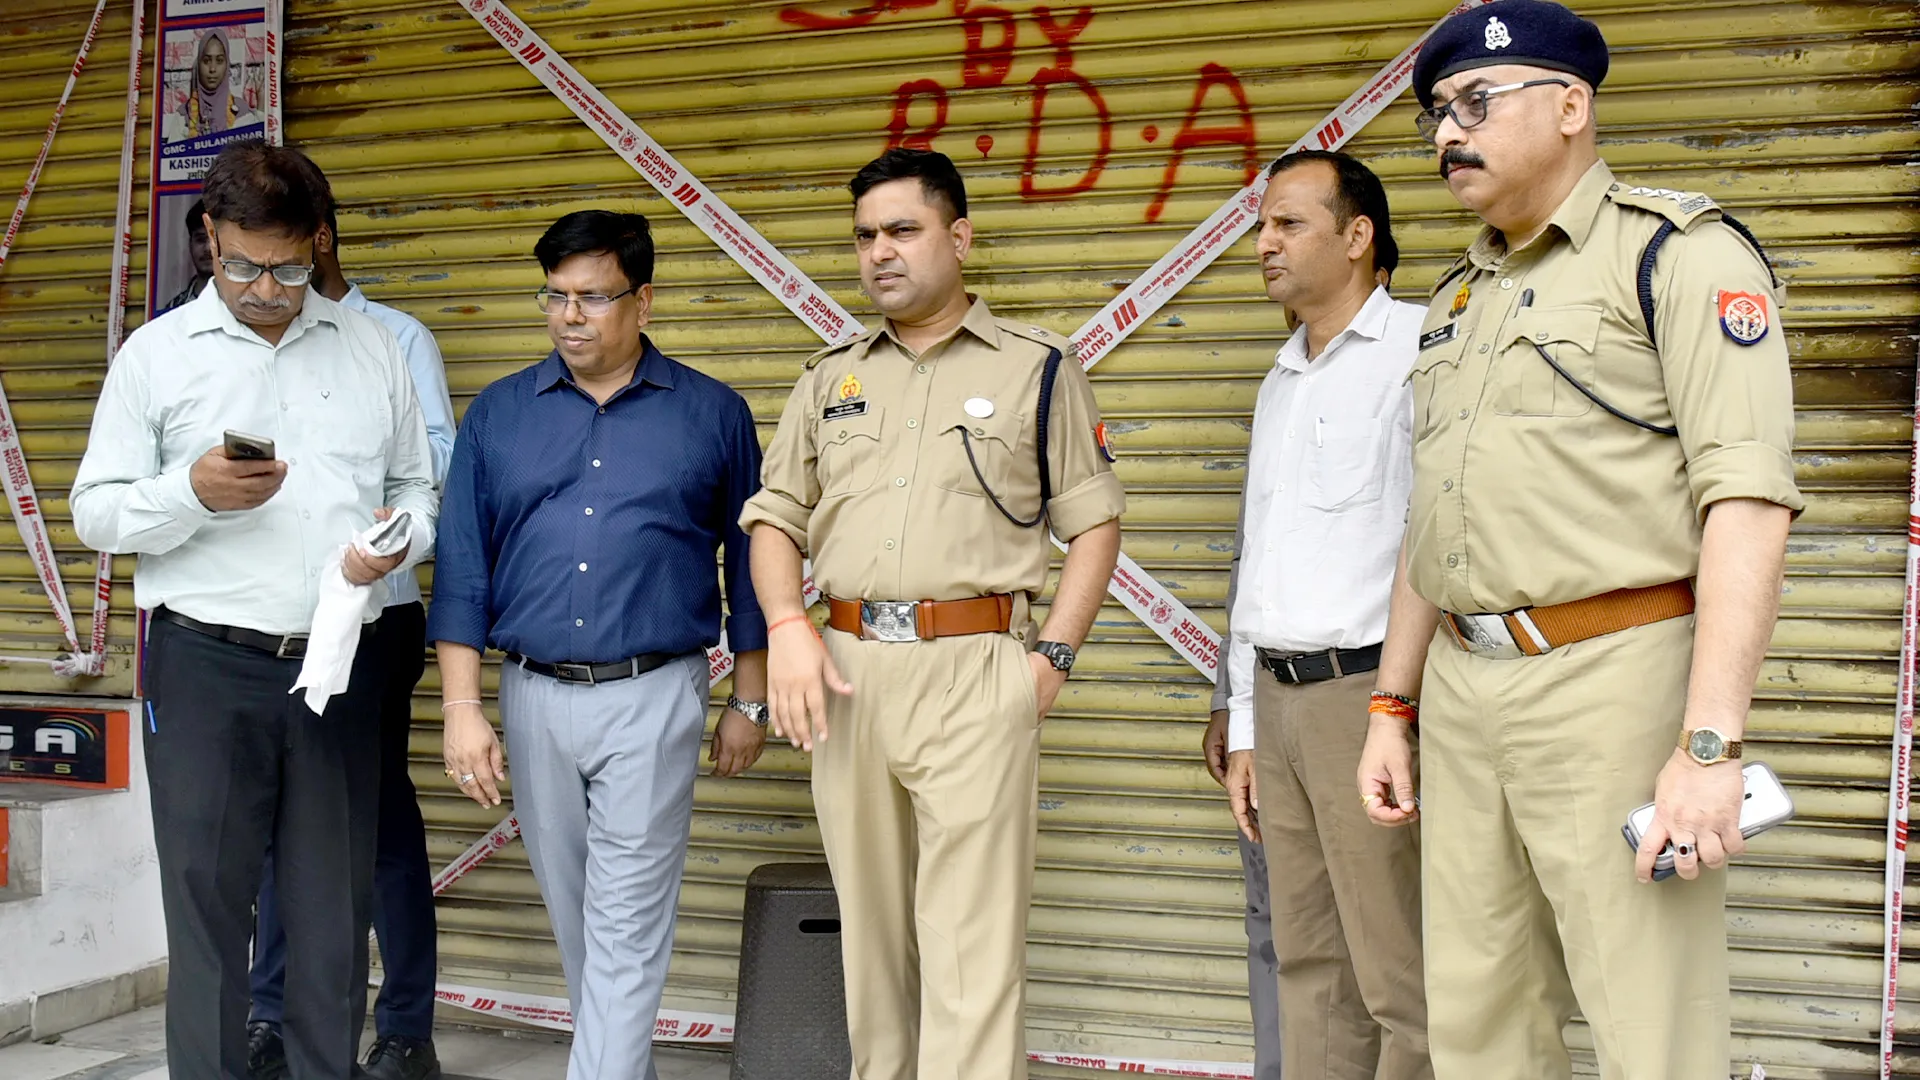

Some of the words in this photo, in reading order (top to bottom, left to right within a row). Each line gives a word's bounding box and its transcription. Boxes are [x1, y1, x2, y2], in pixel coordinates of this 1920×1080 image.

[484, 15, 519, 47] CAUTION
[493, 9, 525, 40] DANGER
[957, 6, 1094, 88] BY
[266, 60, 278, 108] CAUTION
[163, 142, 187, 156] GMC
[643, 147, 677, 179] DANGER
[635, 154, 673, 188] CAUTION
[3, 208, 25, 248] DANGER
[800, 302, 840, 338] CAUTION
[808, 295, 845, 329] DANGER
[1076, 324, 1105, 350] DANG
[4, 449, 22, 490] CAUTION
[11, 447, 28, 487] DANGER
[708, 649, 724, 664] DA
[1172, 627, 1218, 669] CAUTION
[1895, 745, 1907, 810] CAUTION
[434, 990, 466, 1003] DANG
[1056, 1056, 1106, 1069] DANGER
